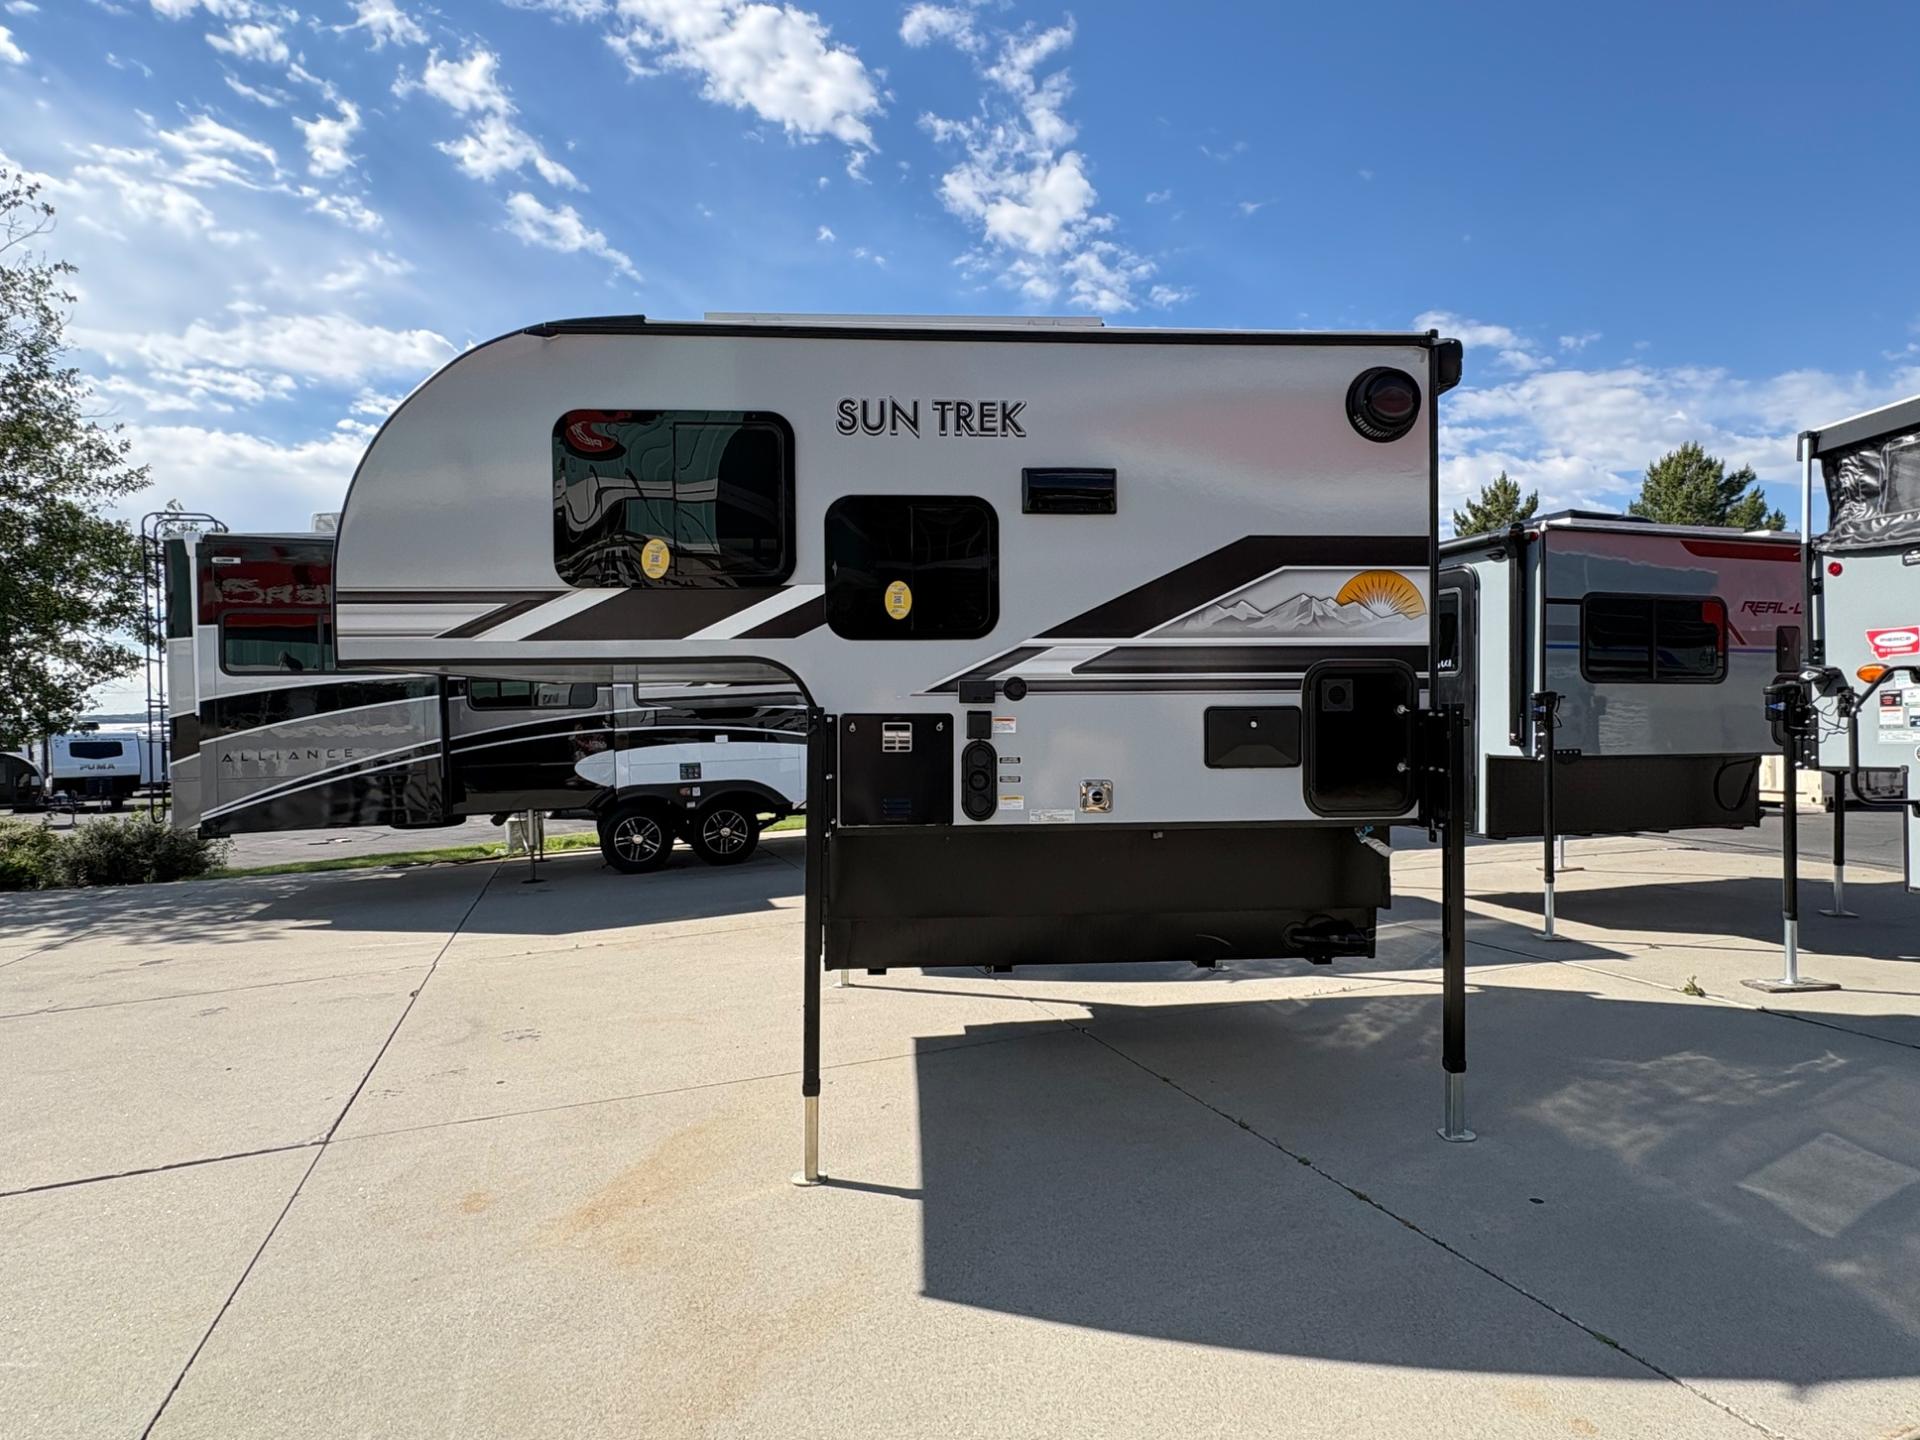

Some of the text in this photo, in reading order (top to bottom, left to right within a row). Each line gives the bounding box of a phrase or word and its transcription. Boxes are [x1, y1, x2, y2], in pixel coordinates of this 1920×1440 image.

[836, 396, 1027, 439] SUN TREK
[221, 748, 353, 763] ALLIANCE
